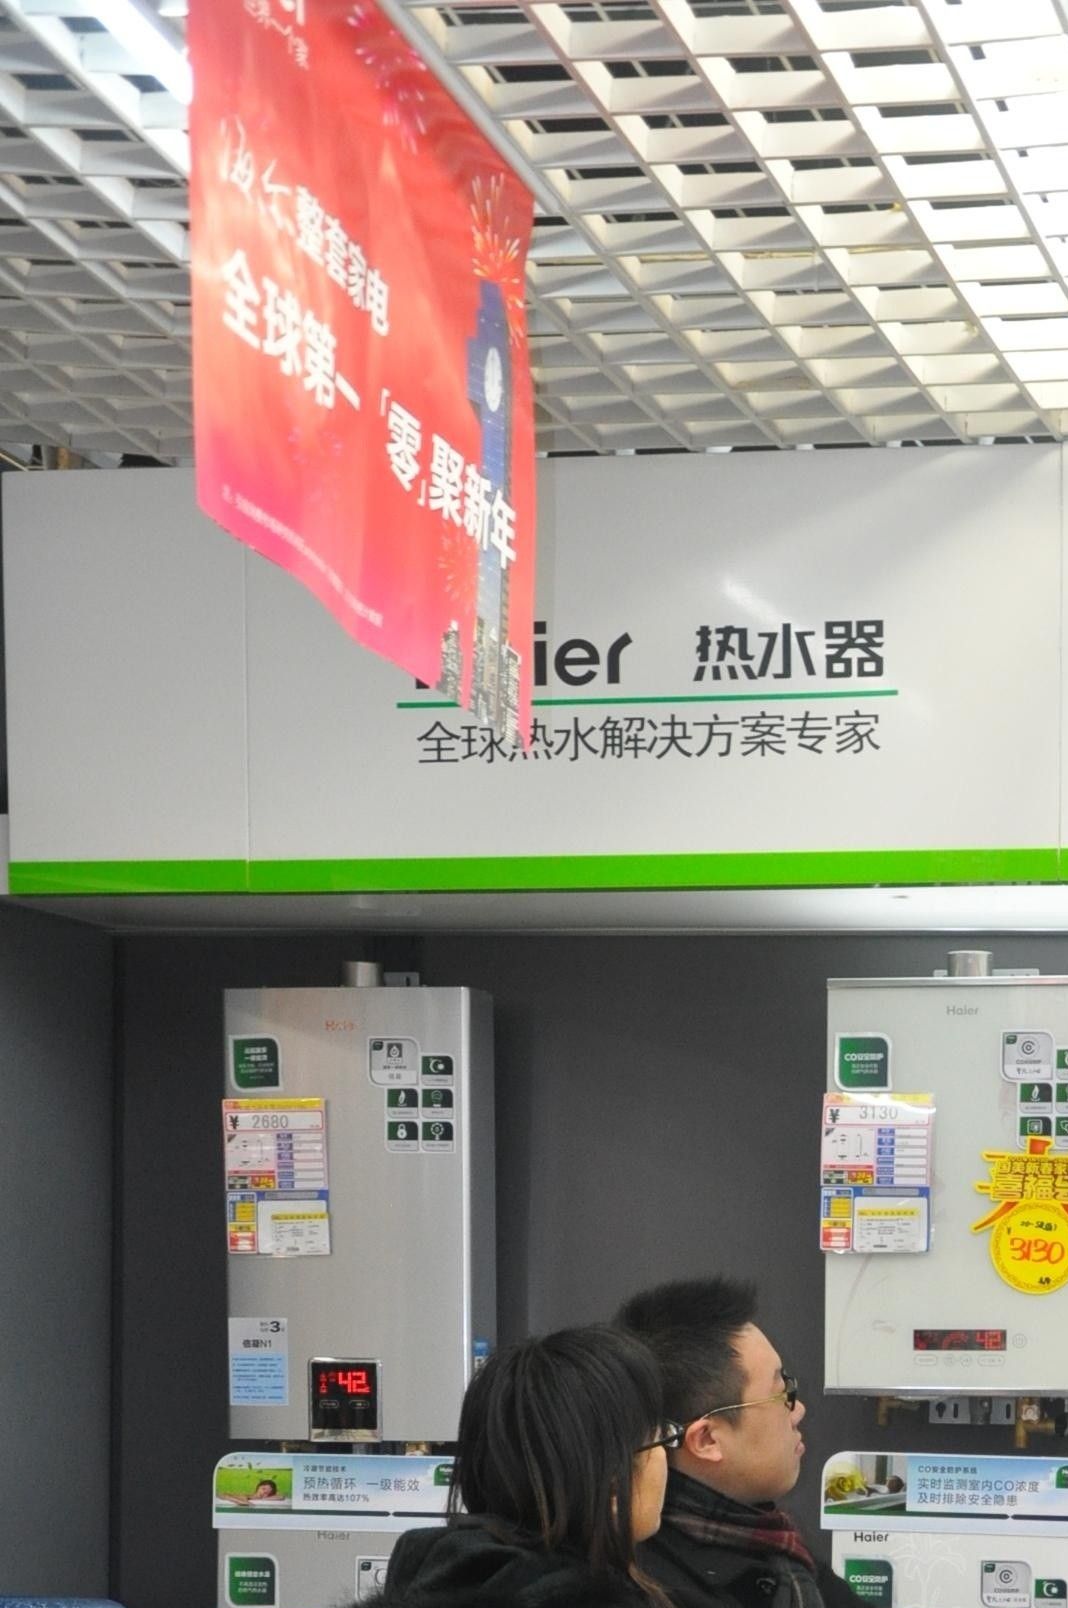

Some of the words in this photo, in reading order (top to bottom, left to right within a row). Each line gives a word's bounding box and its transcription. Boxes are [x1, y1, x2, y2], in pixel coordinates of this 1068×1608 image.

[222, 248, 361, 412] 全球第一
[692, 619, 886, 682] 热水器
[416, 710, 881, 764] 全球热水解决方案专家
[946, 1005, 979, 1017] Haier
[859, 1105, 898, 1120] 3130
[251, 1114, 289, 1129] 2680
[269, 1320, 281, 1333] 3
[338, 1371, 368, 1392] 42
[303, 1477, 356, 1490] 预热循环
[366, 1478, 420, 1492] 一级能效
[917, 1478, 1040, 1493] 实时监测室内CO浓度
[917, 1492, 1018, 1507] 及时排除安全隐患
[853, 1531, 889, 1542] Haier
